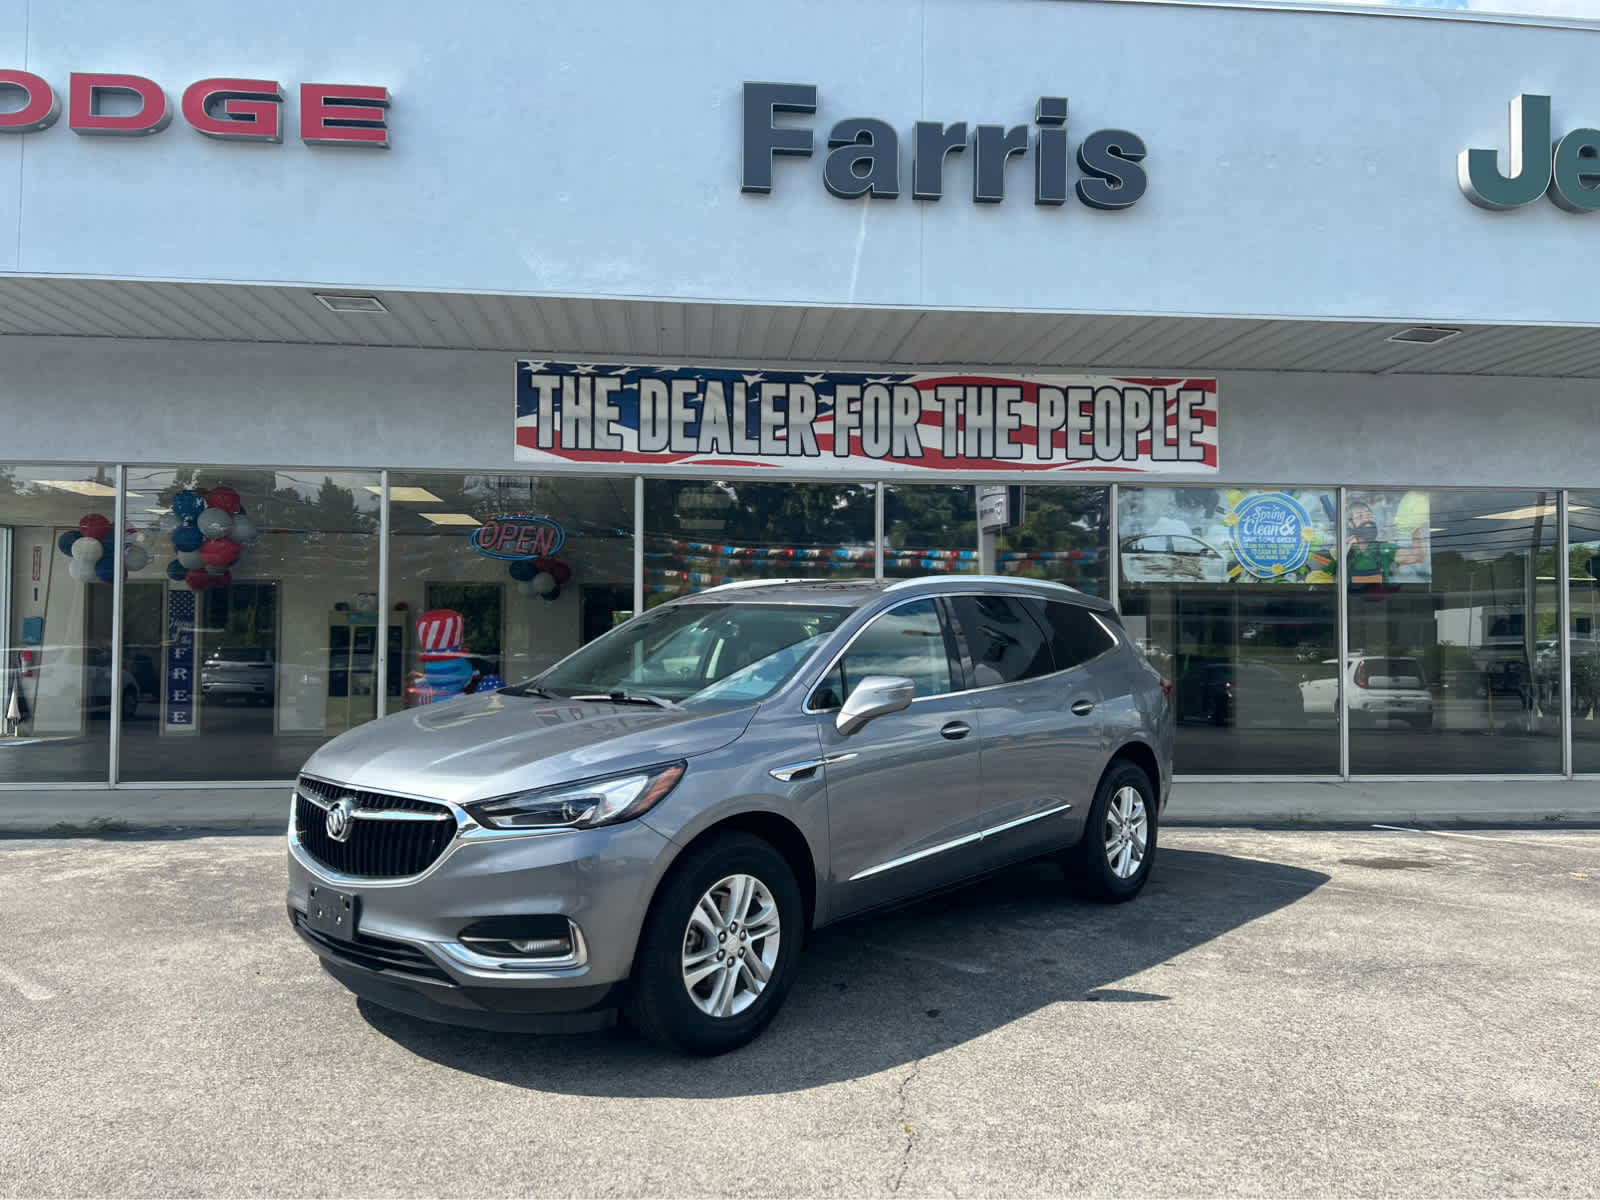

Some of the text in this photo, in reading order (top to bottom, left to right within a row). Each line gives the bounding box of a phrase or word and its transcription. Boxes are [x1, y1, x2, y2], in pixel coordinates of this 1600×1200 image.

[740, 81, 1147, 210] Farris
[530, 374, 1205, 461] THE DEALER FOR THE PEOPLE
[479, 520, 555, 557] OPEN
[1242, 515, 1296, 536] Clean &
[1252, 505, 1286, 524] Spring
[173, 648, 188, 723] FREE
